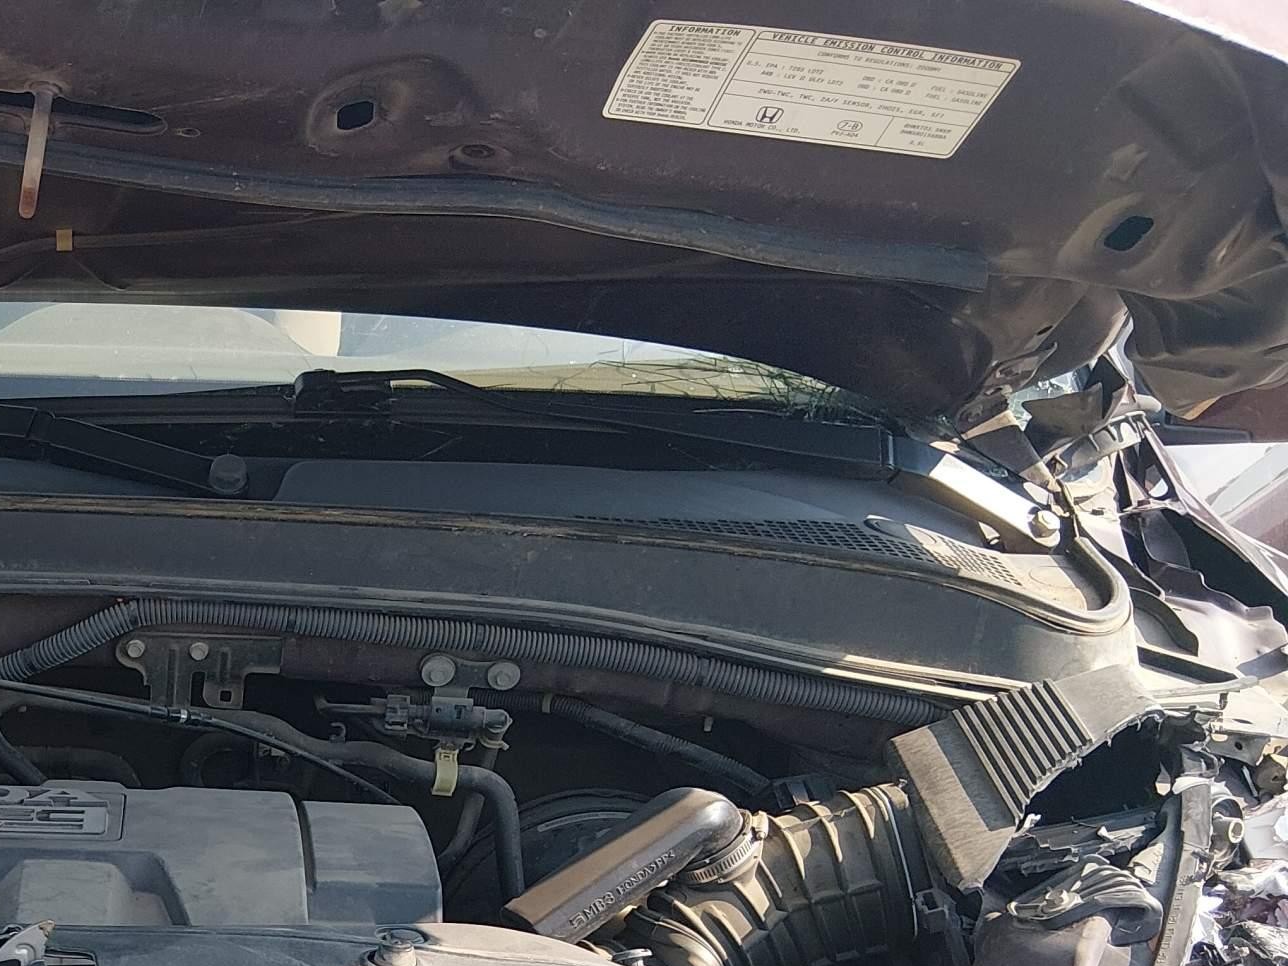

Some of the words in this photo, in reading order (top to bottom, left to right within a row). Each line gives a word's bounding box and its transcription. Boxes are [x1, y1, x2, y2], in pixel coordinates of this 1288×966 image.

[669, 25, 742, 37] INFORMATION
[772, 32, 818, 45] VEHICLE
[823, 38, 875, 52] EMISSION
[880, 45, 925, 59] CONTROL
[933, 53, 1003, 70] INFORMATION
